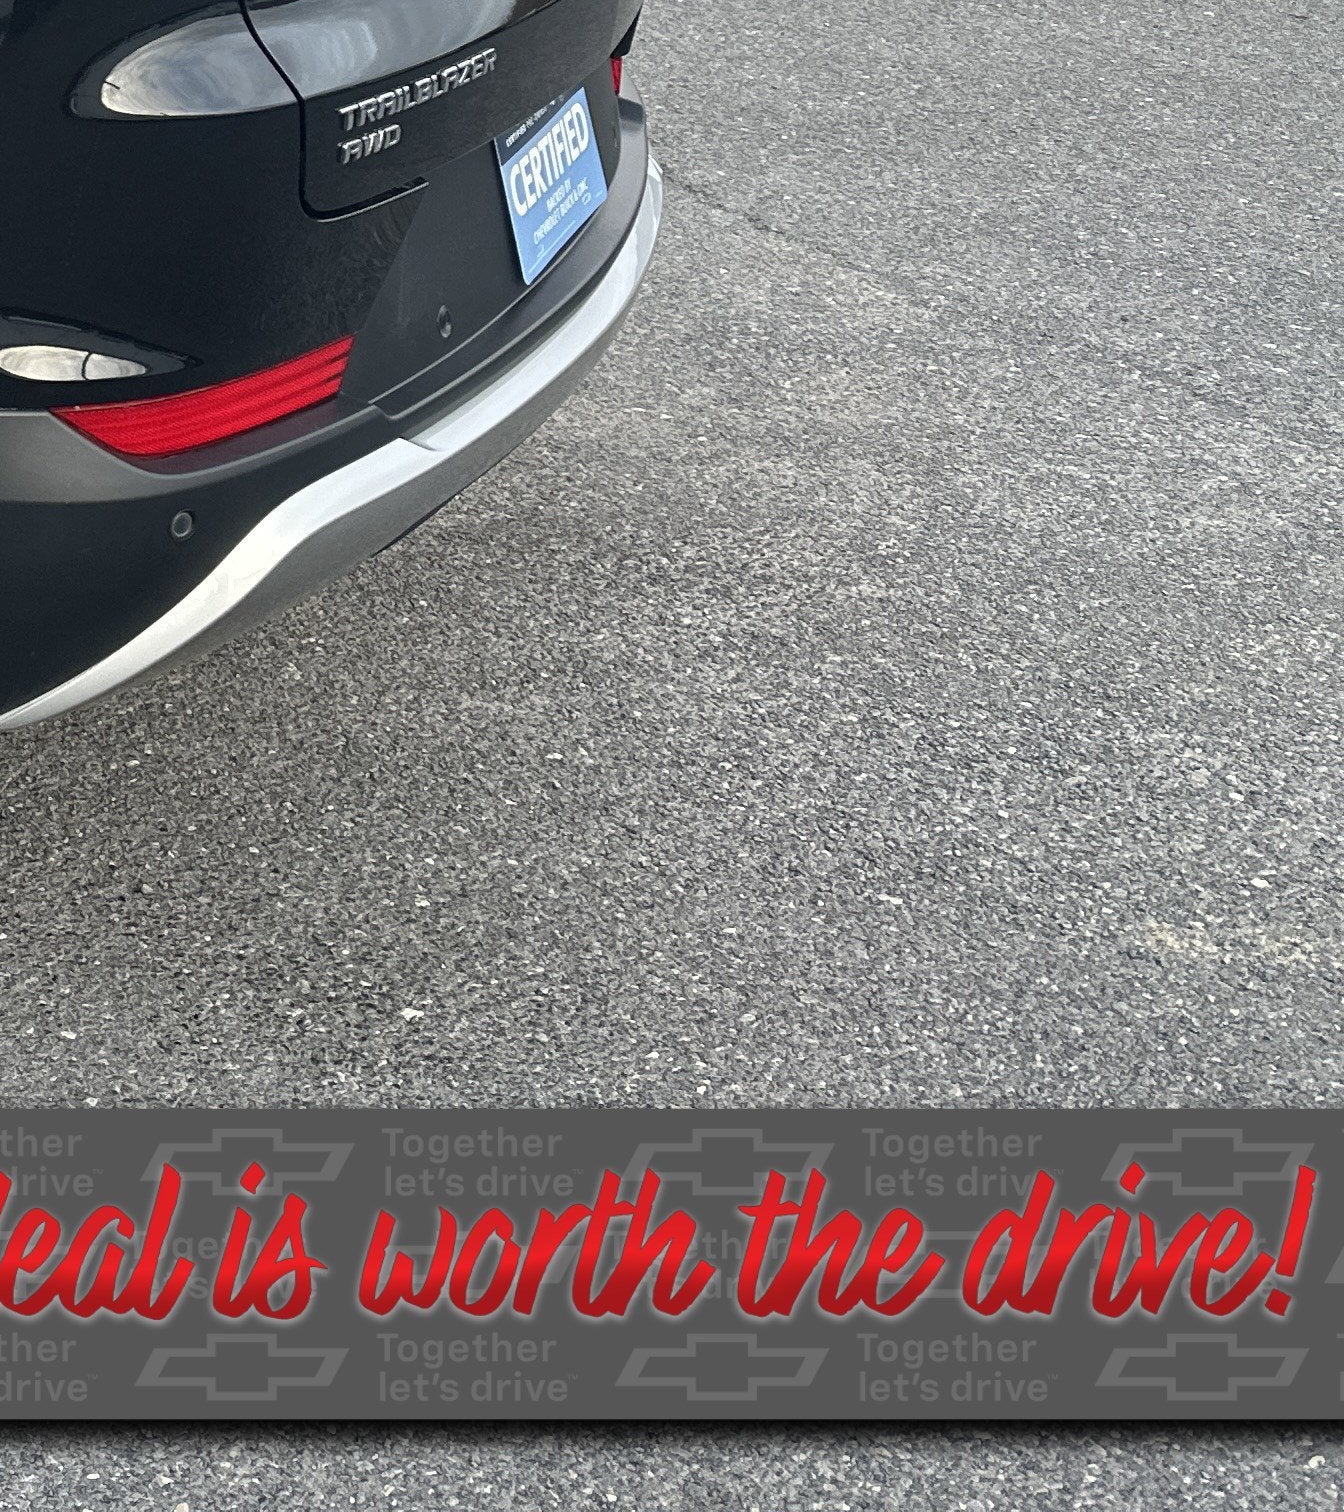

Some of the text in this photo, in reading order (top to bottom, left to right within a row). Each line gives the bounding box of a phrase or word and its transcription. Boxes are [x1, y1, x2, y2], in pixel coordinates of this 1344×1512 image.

[337, 47, 497, 131] TRAILBLAZER
[337, 124, 402, 165] AWD
[509, 102, 589, 217] CERTIFIED
